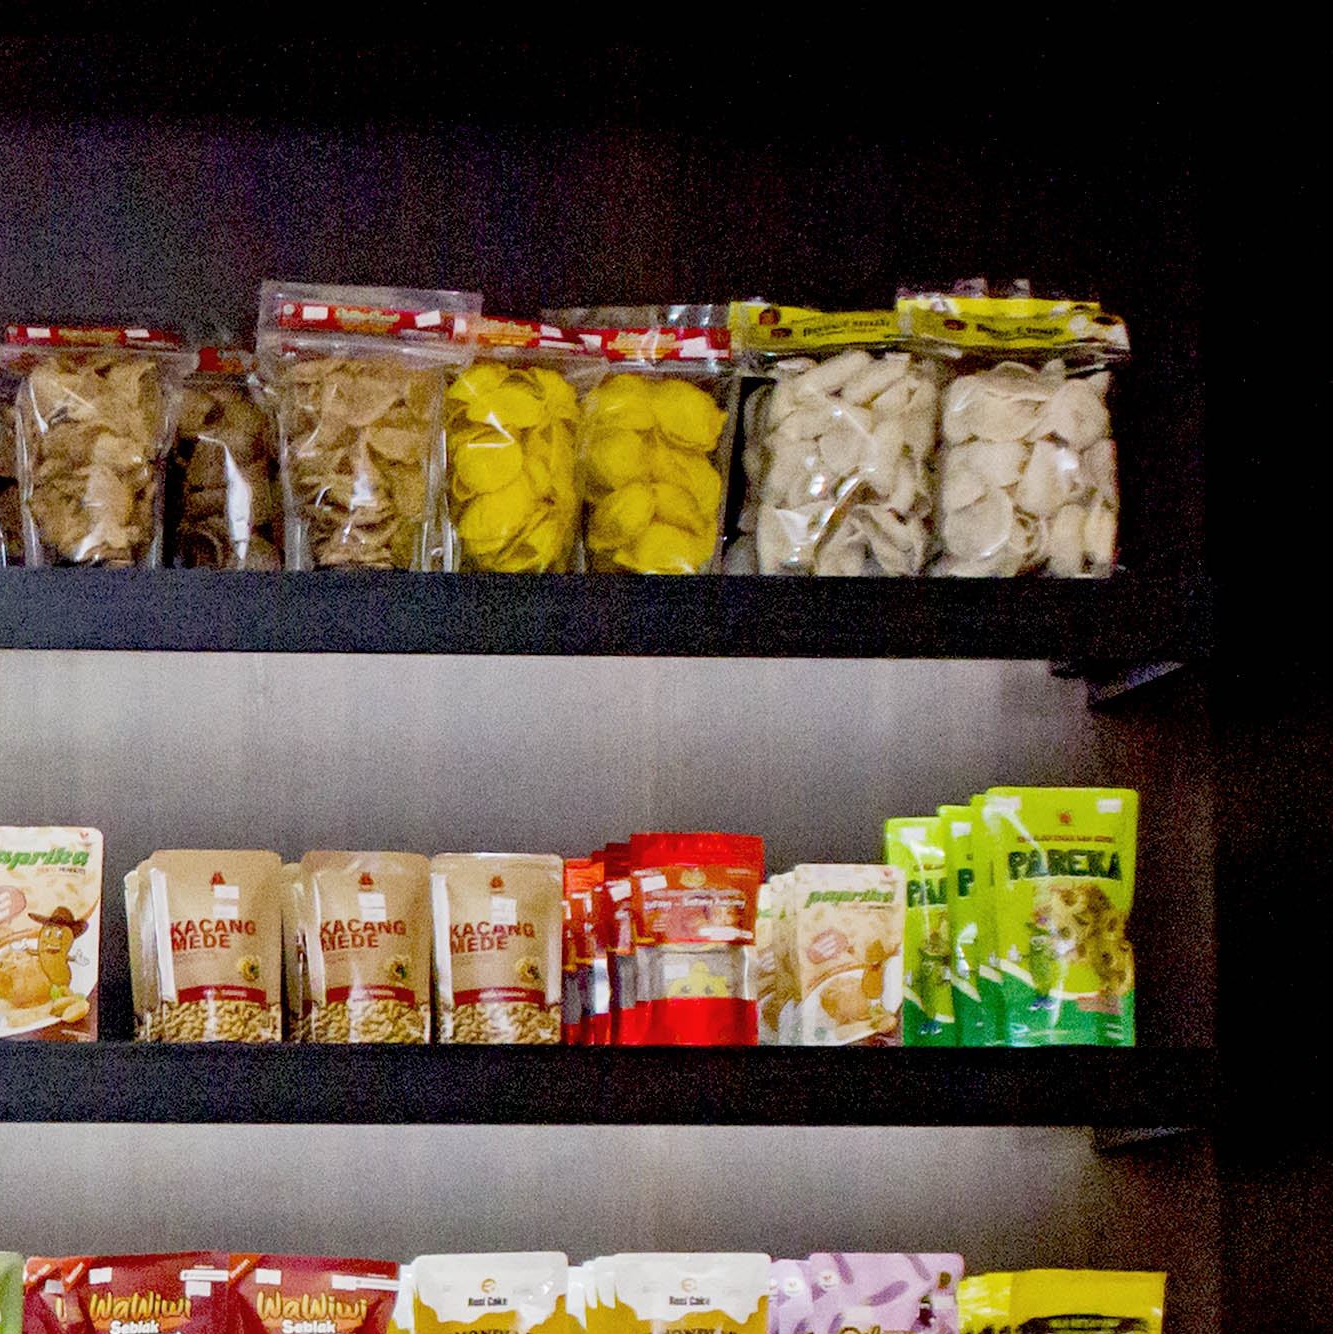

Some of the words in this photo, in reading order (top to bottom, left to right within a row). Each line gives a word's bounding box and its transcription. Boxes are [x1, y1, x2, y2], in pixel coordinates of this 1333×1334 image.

[170, 919, 256, 936] KACANG
[319, 919, 406, 936] KACANG
[449, 921, 534, 938] KACANG
[171, 934, 231, 951] MEDE
[321, 934, 379, 951] MEDE
[450, 936, 509, 954] MEDE
